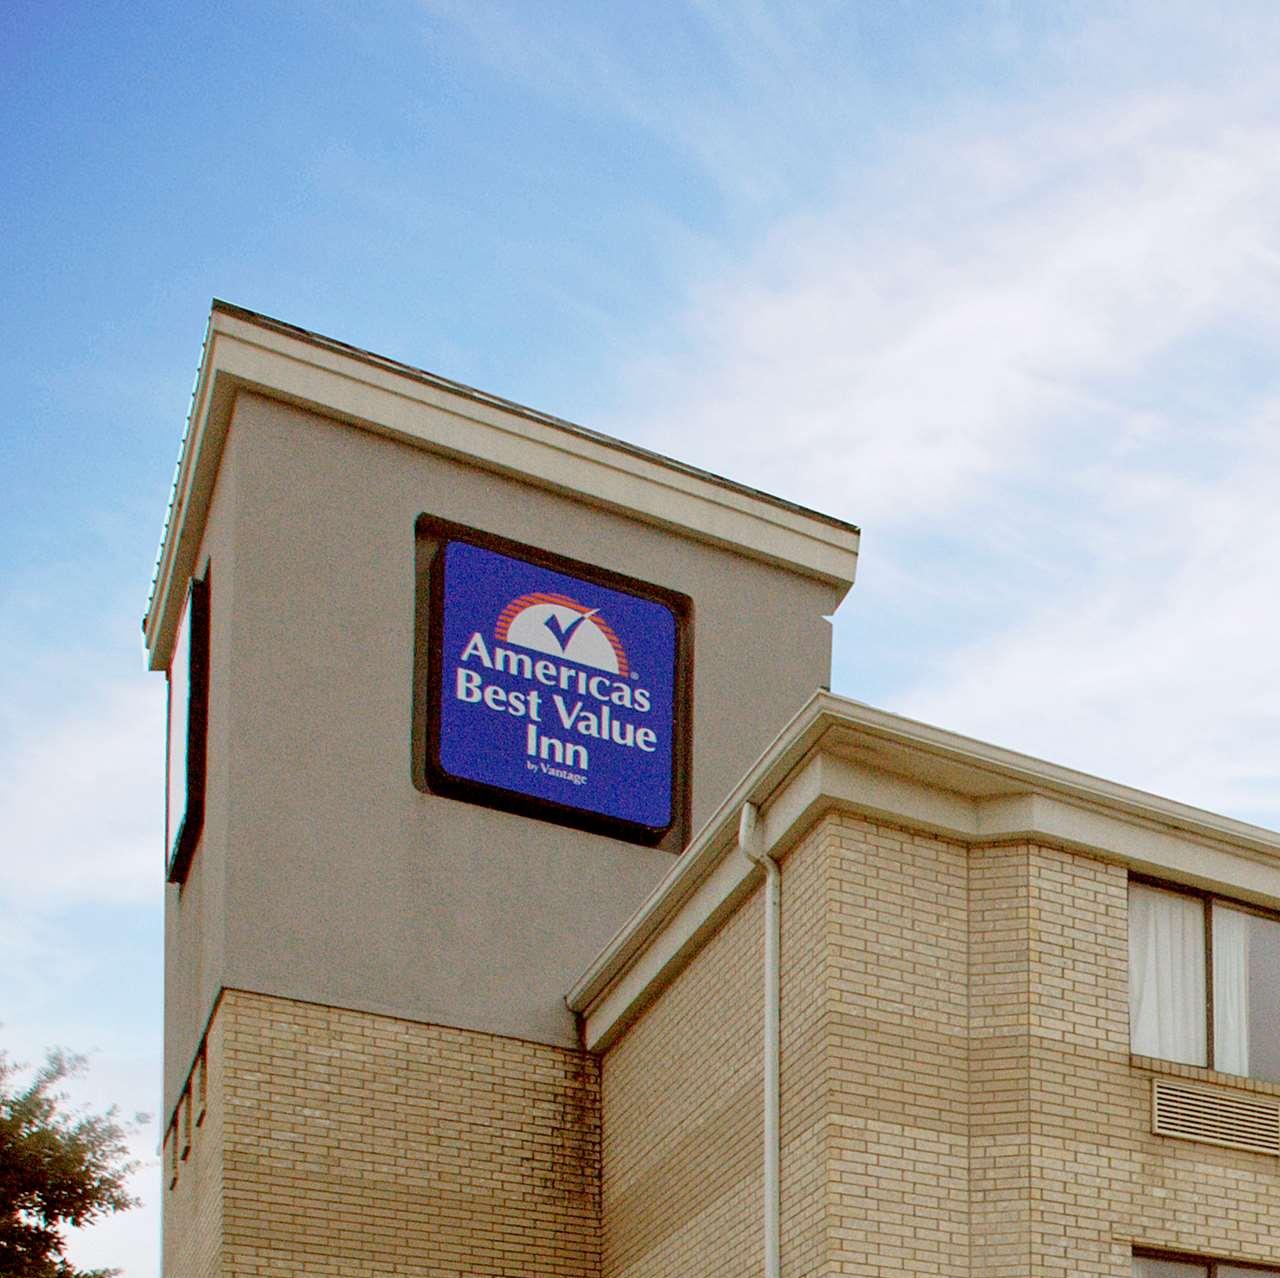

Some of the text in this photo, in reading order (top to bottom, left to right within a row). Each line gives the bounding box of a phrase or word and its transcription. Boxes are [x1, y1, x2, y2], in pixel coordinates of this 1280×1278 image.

[461, 632, 650, 712] Americas
[457, 668, 657, 752] Best Value
[527, 724, 589, 770] Inn
[527, 760, 587, 785] by Vantage
